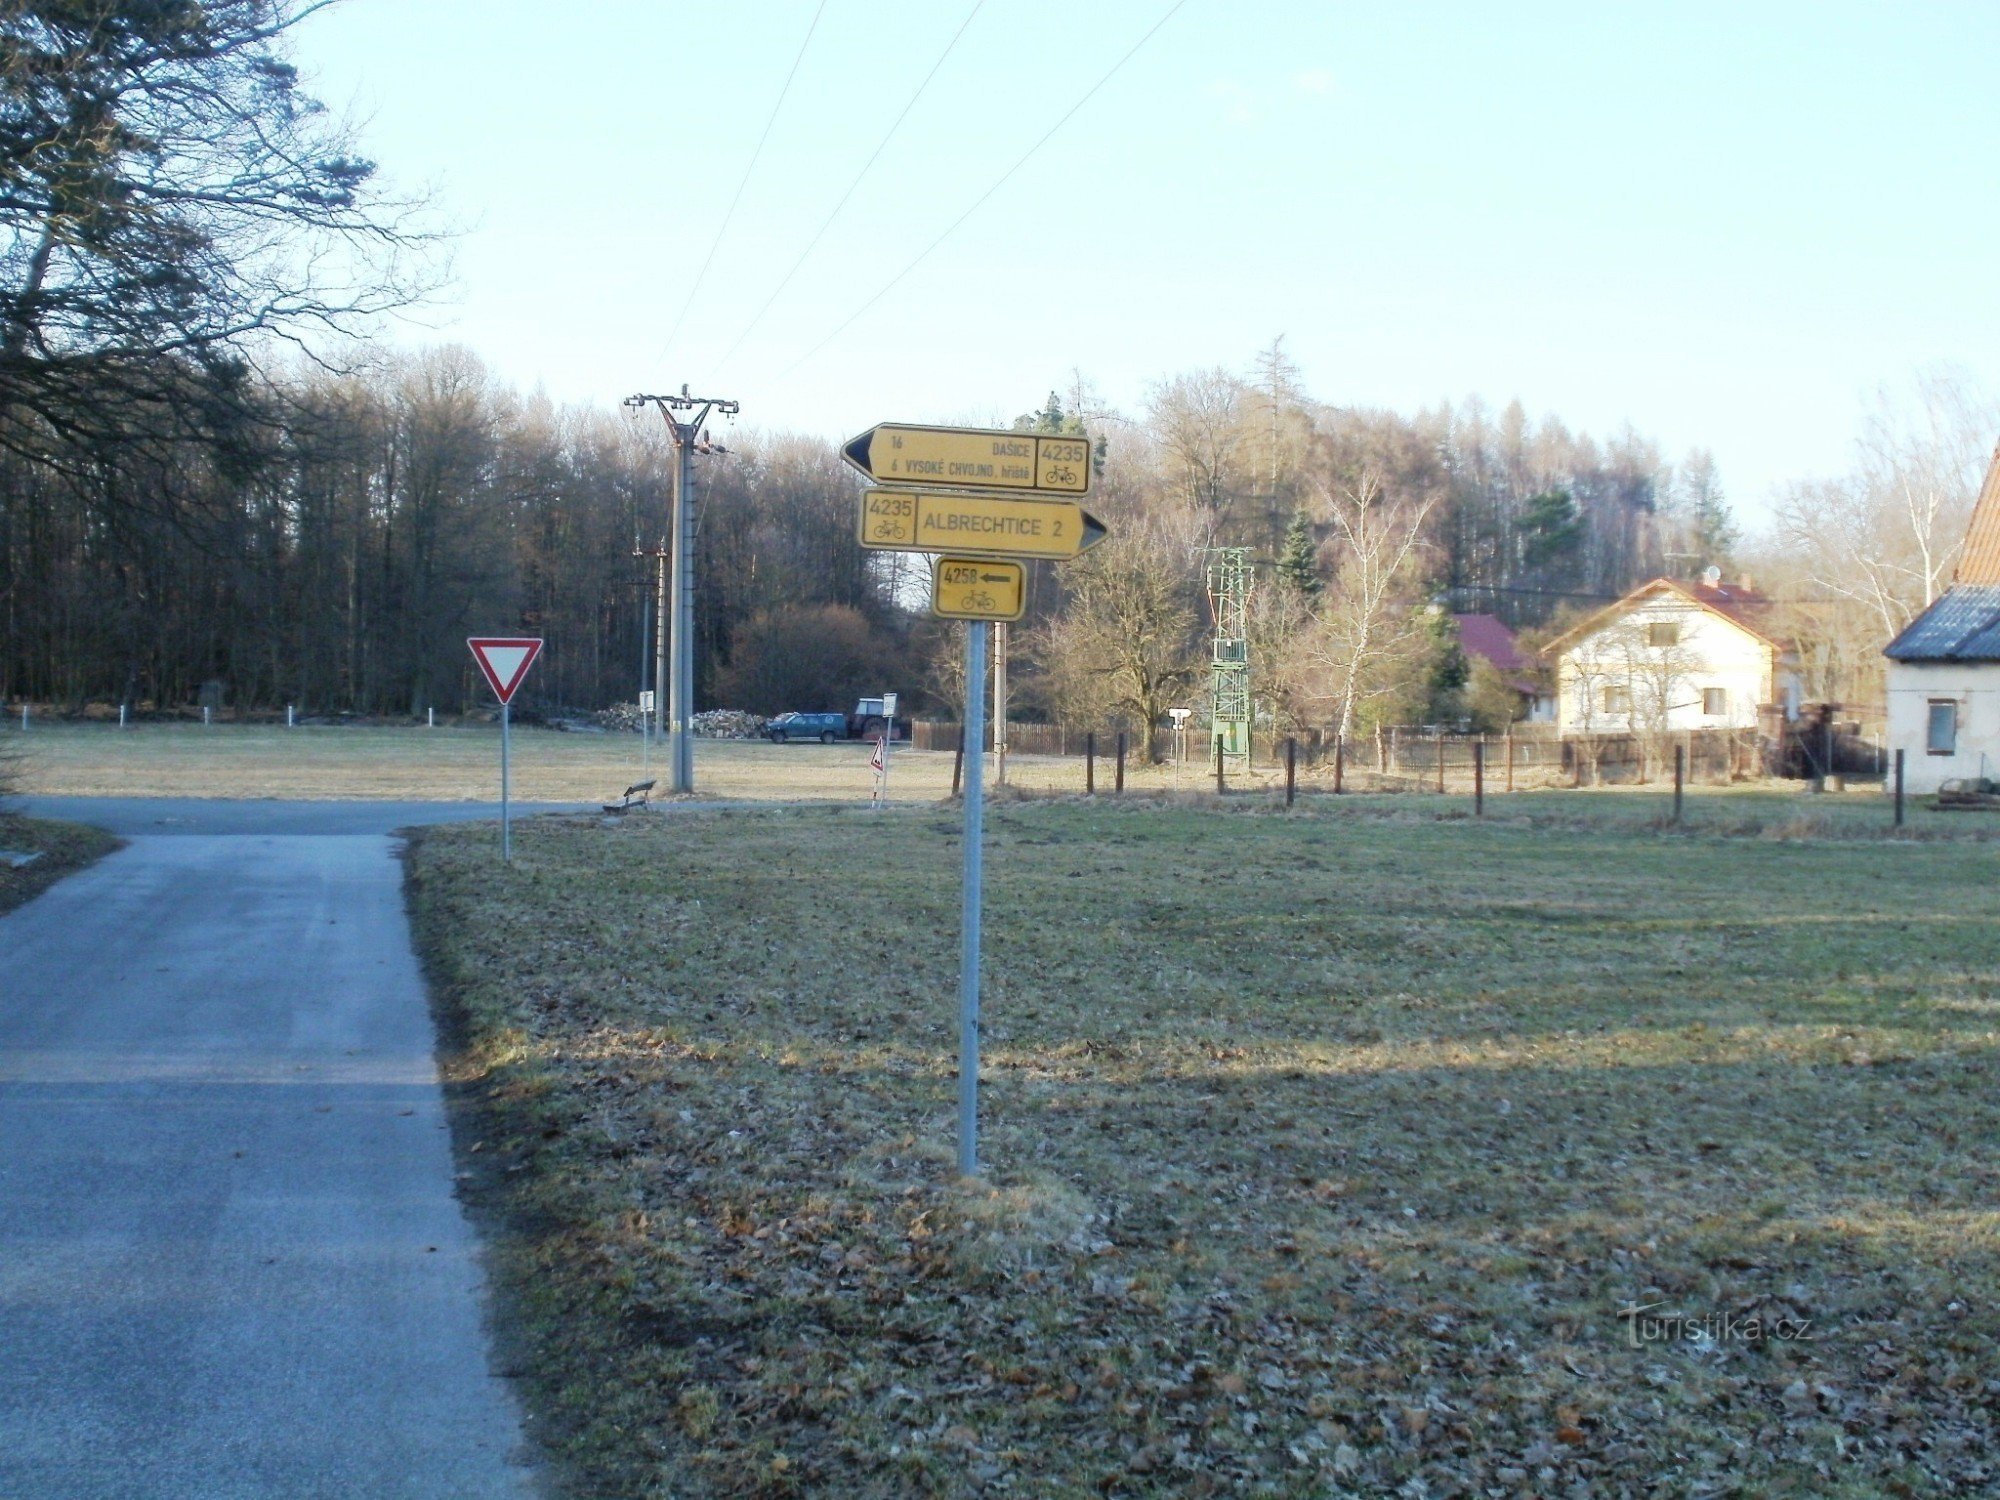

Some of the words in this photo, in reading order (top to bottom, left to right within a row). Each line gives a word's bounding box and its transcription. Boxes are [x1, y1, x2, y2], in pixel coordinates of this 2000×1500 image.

[891, 435, 903, 449] 16
[992, 439, 1030, 458] DAŠICE
[1042, 444, 1084, 462] 4235
[891, 461, 898, 472] 6
[905, 458, 945, 475] VYSOKÉ
[869, 498, 912, 517] 4235
[923, 512, 1042, 536] ALBRECHTICE
[1052, 520, 1063, 538] 2
[944, 567, 978, 584] 4258
